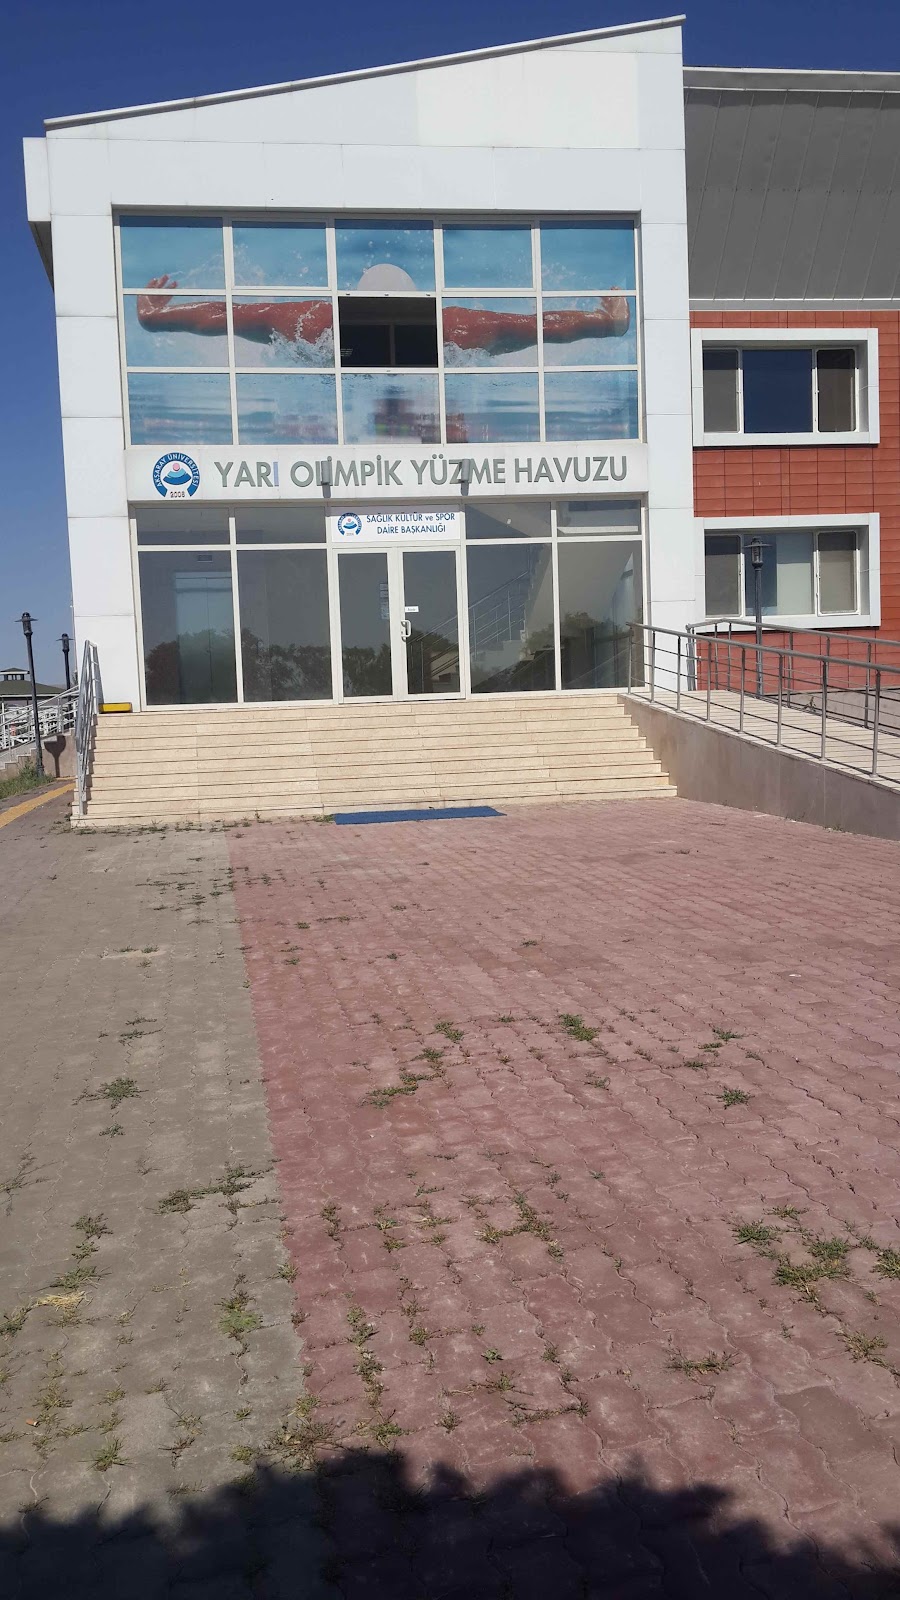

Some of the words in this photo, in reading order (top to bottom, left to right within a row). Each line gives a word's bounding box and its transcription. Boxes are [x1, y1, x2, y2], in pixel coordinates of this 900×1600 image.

[153, 457, 167, 487] AKSARAY
[213, 461, 280, 488] YARI
[290, 454, 403, 487] OLİMPİK
[410, 453, 506, 485] YÜZME
[514, 456, 627, 483] HAVUZU
[366, 512, 393, 523] SAĞLIK
[395, 511, 423, 522] KÜLTÜR
[435, 512, 456, 521] SPOR
[377, 523, 399, 534] DAİRE
[401, 522, 446, 534] BAŞKANLIĞI
